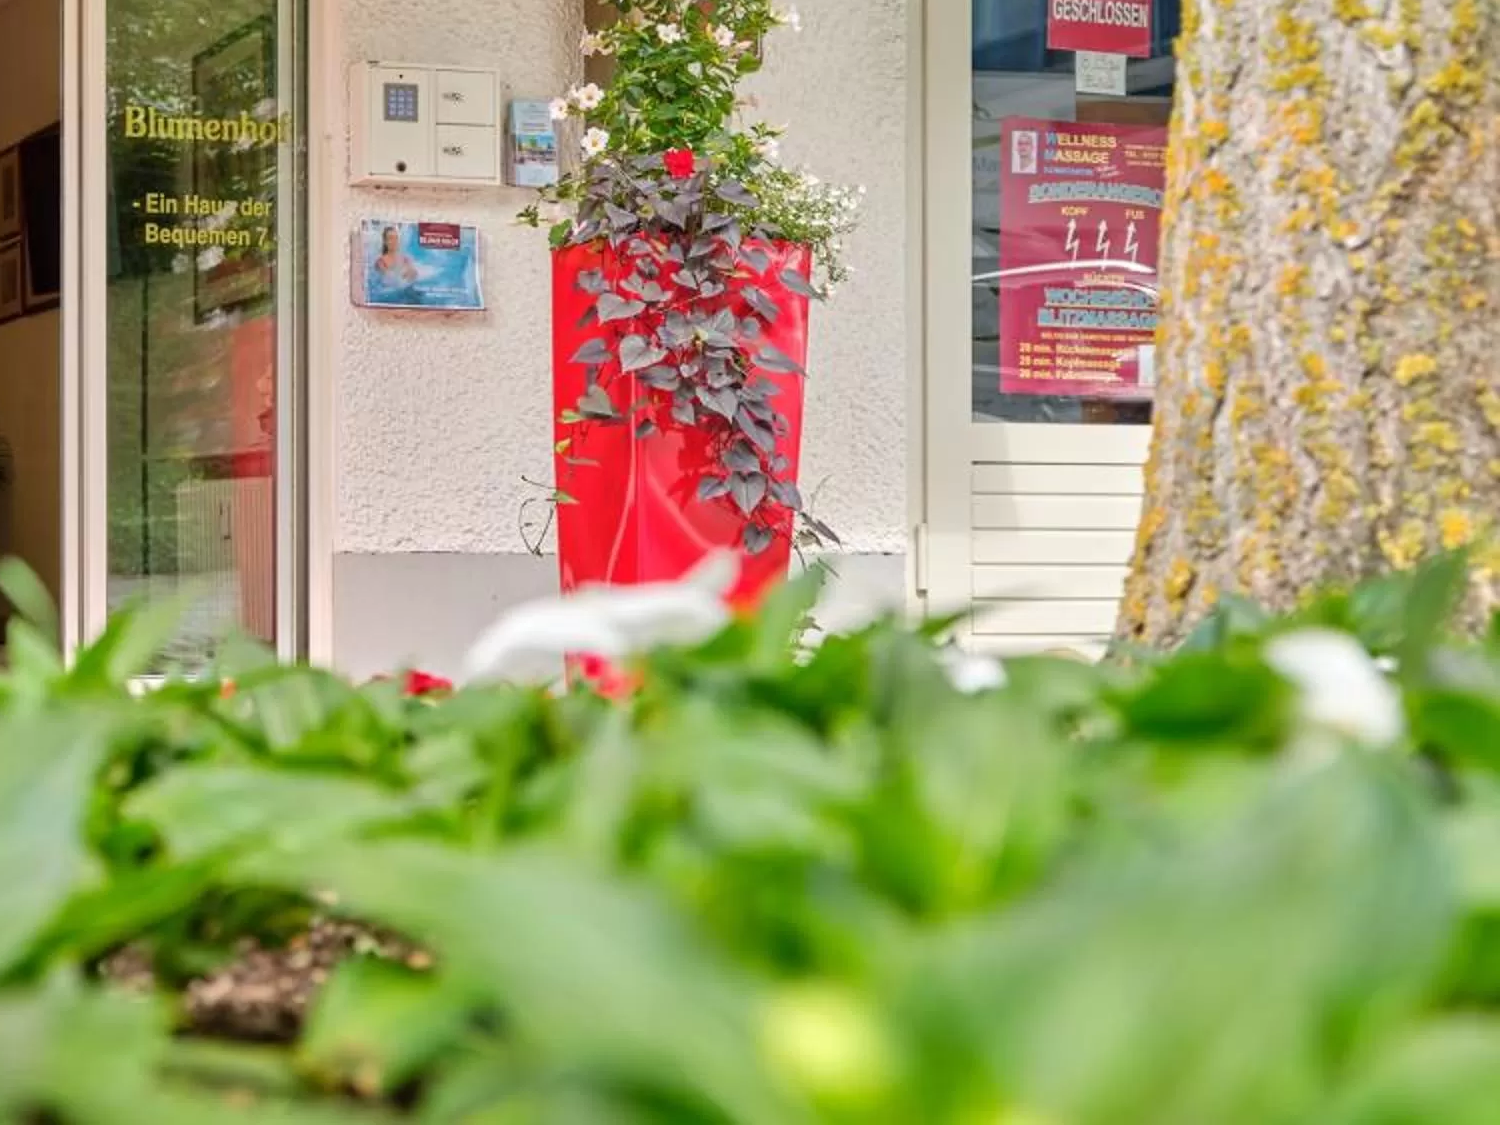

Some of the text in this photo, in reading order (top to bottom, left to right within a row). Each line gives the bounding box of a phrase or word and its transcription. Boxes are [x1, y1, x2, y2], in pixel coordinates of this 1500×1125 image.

[124, 105, 292, 143] Blumenhof
[1045, 131, 1118, 149] WELLNESS
[1043, 148, 1110, 165] MASSAGE
[145, 193, 178, 214] Ein
[184, 195, 238, 217] Hau
[240, 196, 273, 217] der
[145, 223, 250, 248] Bequemen
